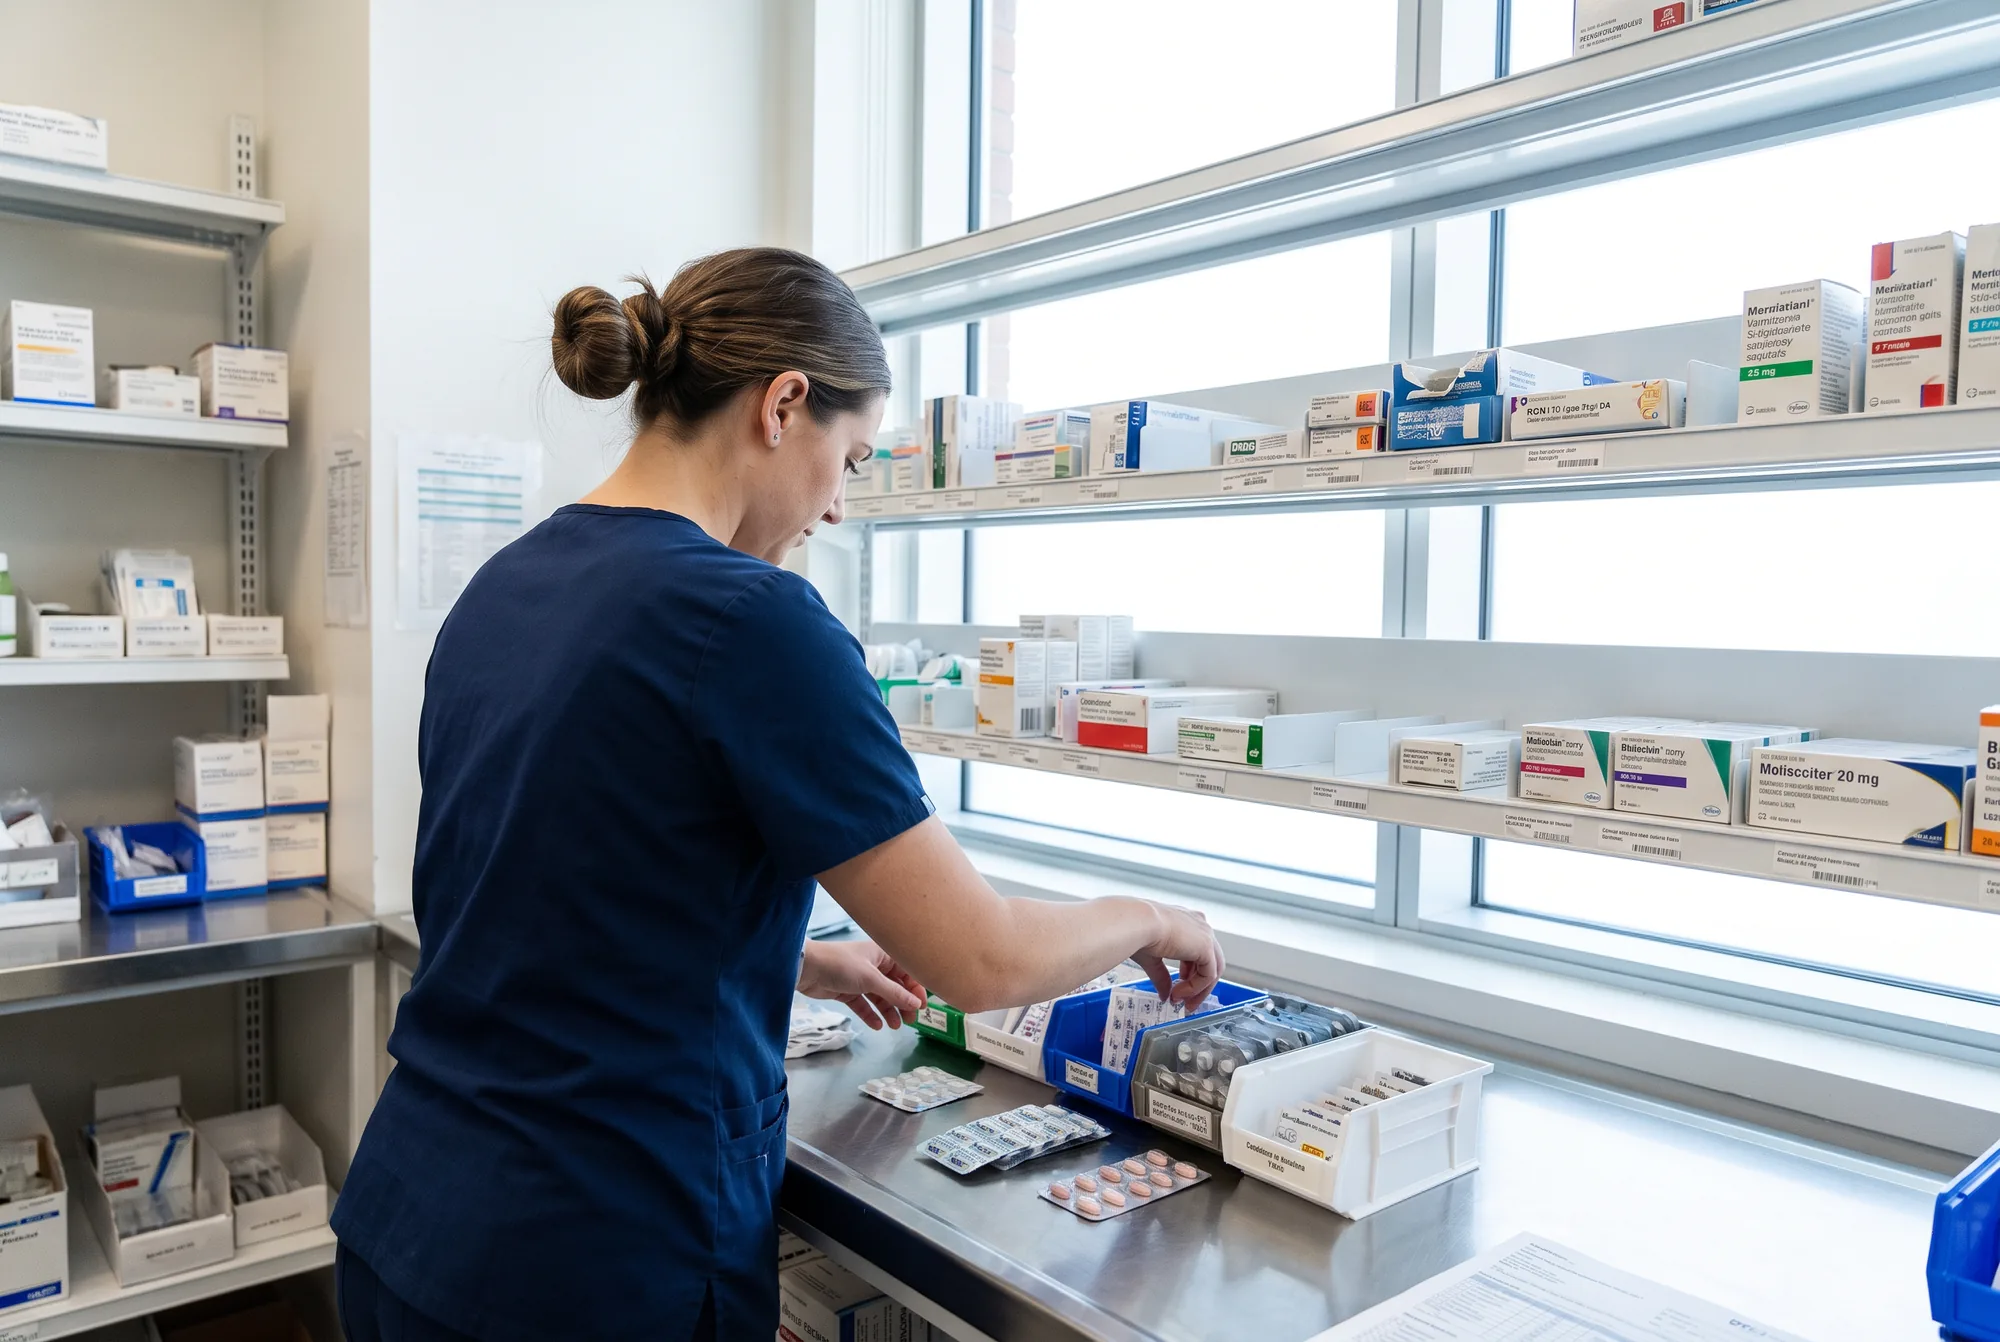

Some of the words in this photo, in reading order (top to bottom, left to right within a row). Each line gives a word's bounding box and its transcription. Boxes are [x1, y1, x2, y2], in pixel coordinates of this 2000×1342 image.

[1747, 368, 1760, 377] 25
[1761, 368, 1776, 376] mg
[1837, 770, 1854, 782] 20
[1857, 774, 1879, 787] mg
